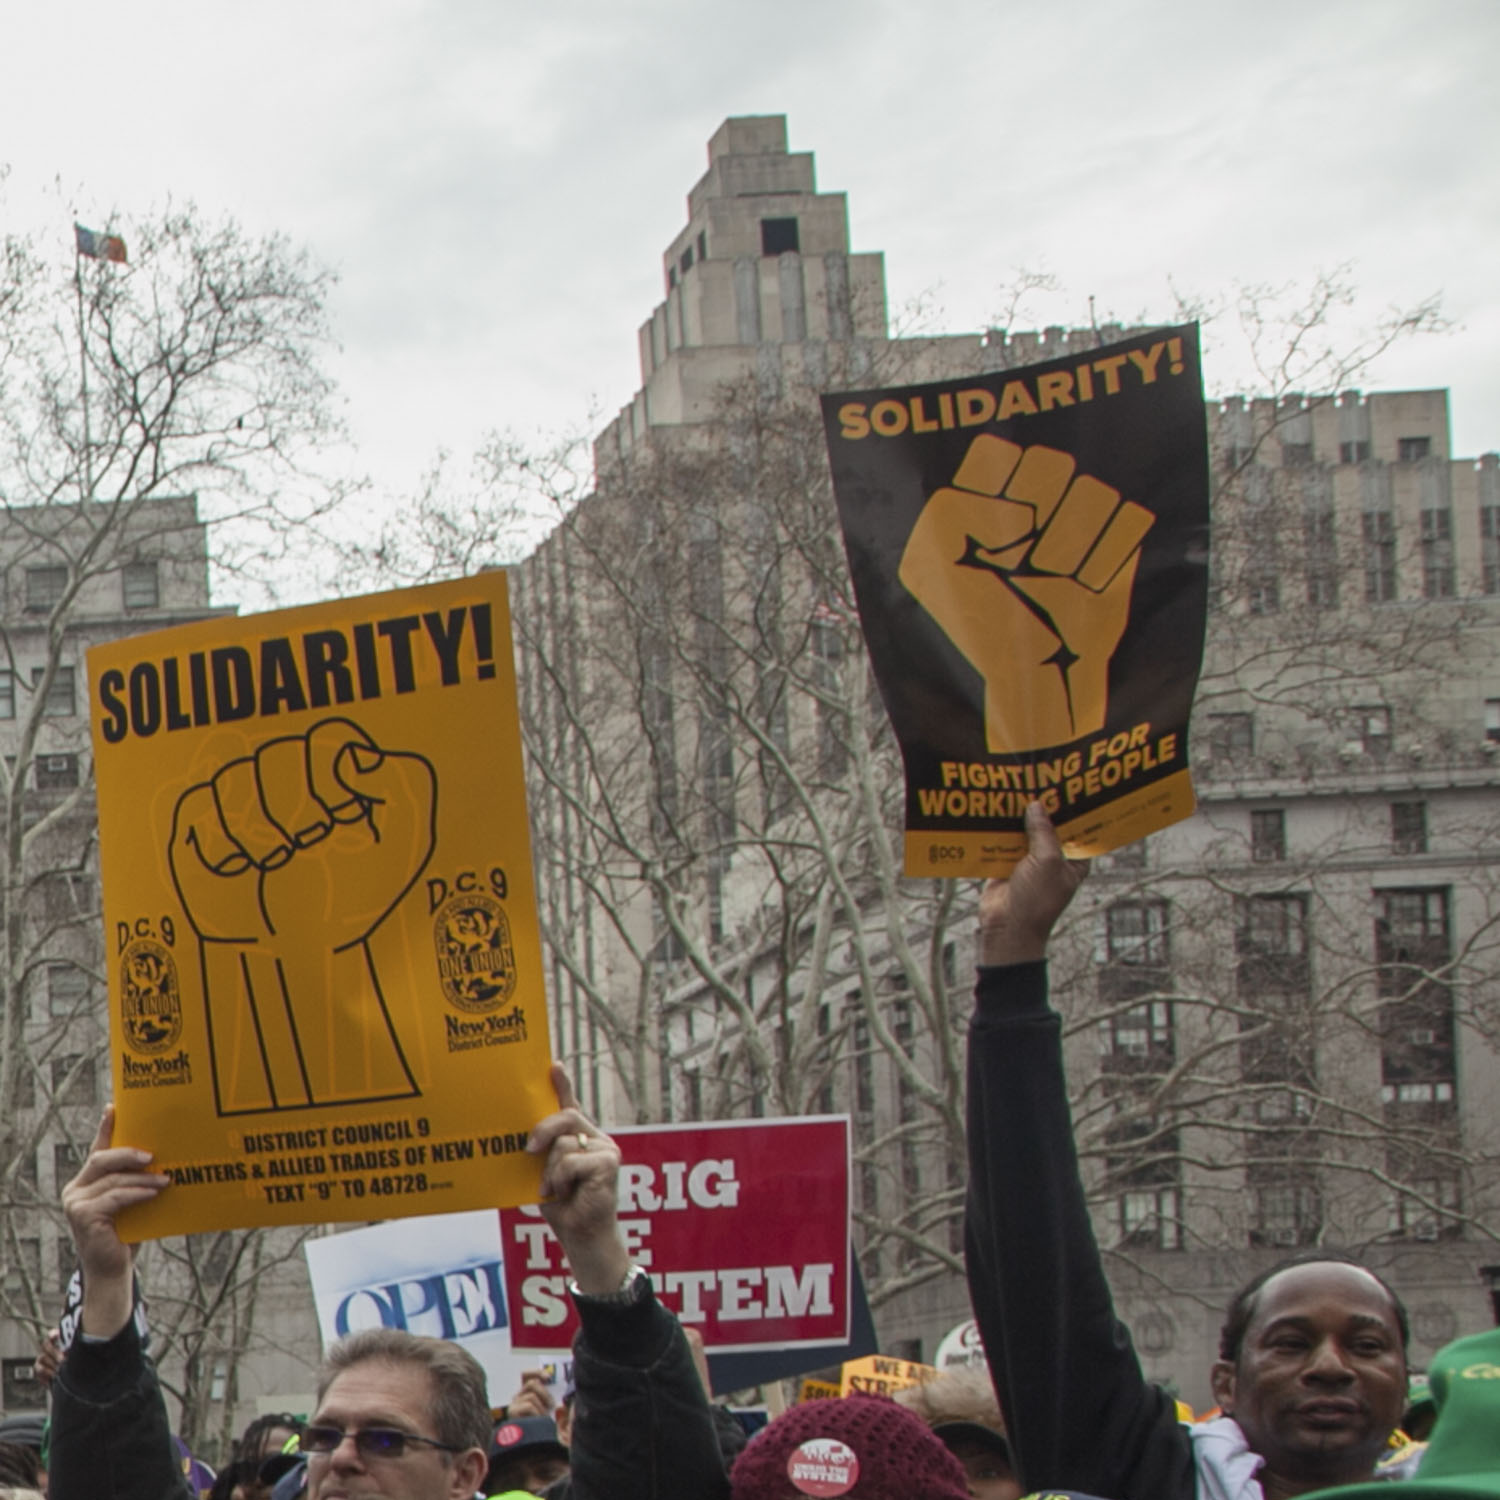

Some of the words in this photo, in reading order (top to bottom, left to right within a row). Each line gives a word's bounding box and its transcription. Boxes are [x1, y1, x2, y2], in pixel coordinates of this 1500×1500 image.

[837, 336, 1184, 440] SOLIDARITY!
[99, 602, 496, 744] SOLIDARITY!
[918, 787, 1060, 818] WORKING
[1066, 733, 1177, 804] PEOPLE
[941, 752, 1082, 790] FIGHTING
[1089, 722, 1150, 766] FOR
[490, 867, 508, 899] 9
[160, 915, 176, 947] 9
[445, 1014, 485, 1037] New
[486, 1005, 526, 1030] York
[243, 1125, 329, 1154] DISTRICT
[333, 1120, 413, 1146] COUNCIL
[417, 1117, 431, 1138] 9
[252, 1159, 265, 1179] &
[269, 1154, 326, 1179] ALLIED
[330, 1148, 400, 1174] TRADES
[405, 1144, 427, 1166] OF
[431, 1140, 474, 1164] NEW
[477, 1131, 529, 1157] YORK
[264, 1183, 306, 1204] TEXT
[341, 1179, 365, 1199] TO
[370, 1174, 428, 1197] 48728
[619, 1158, 740, 1213] RIG
